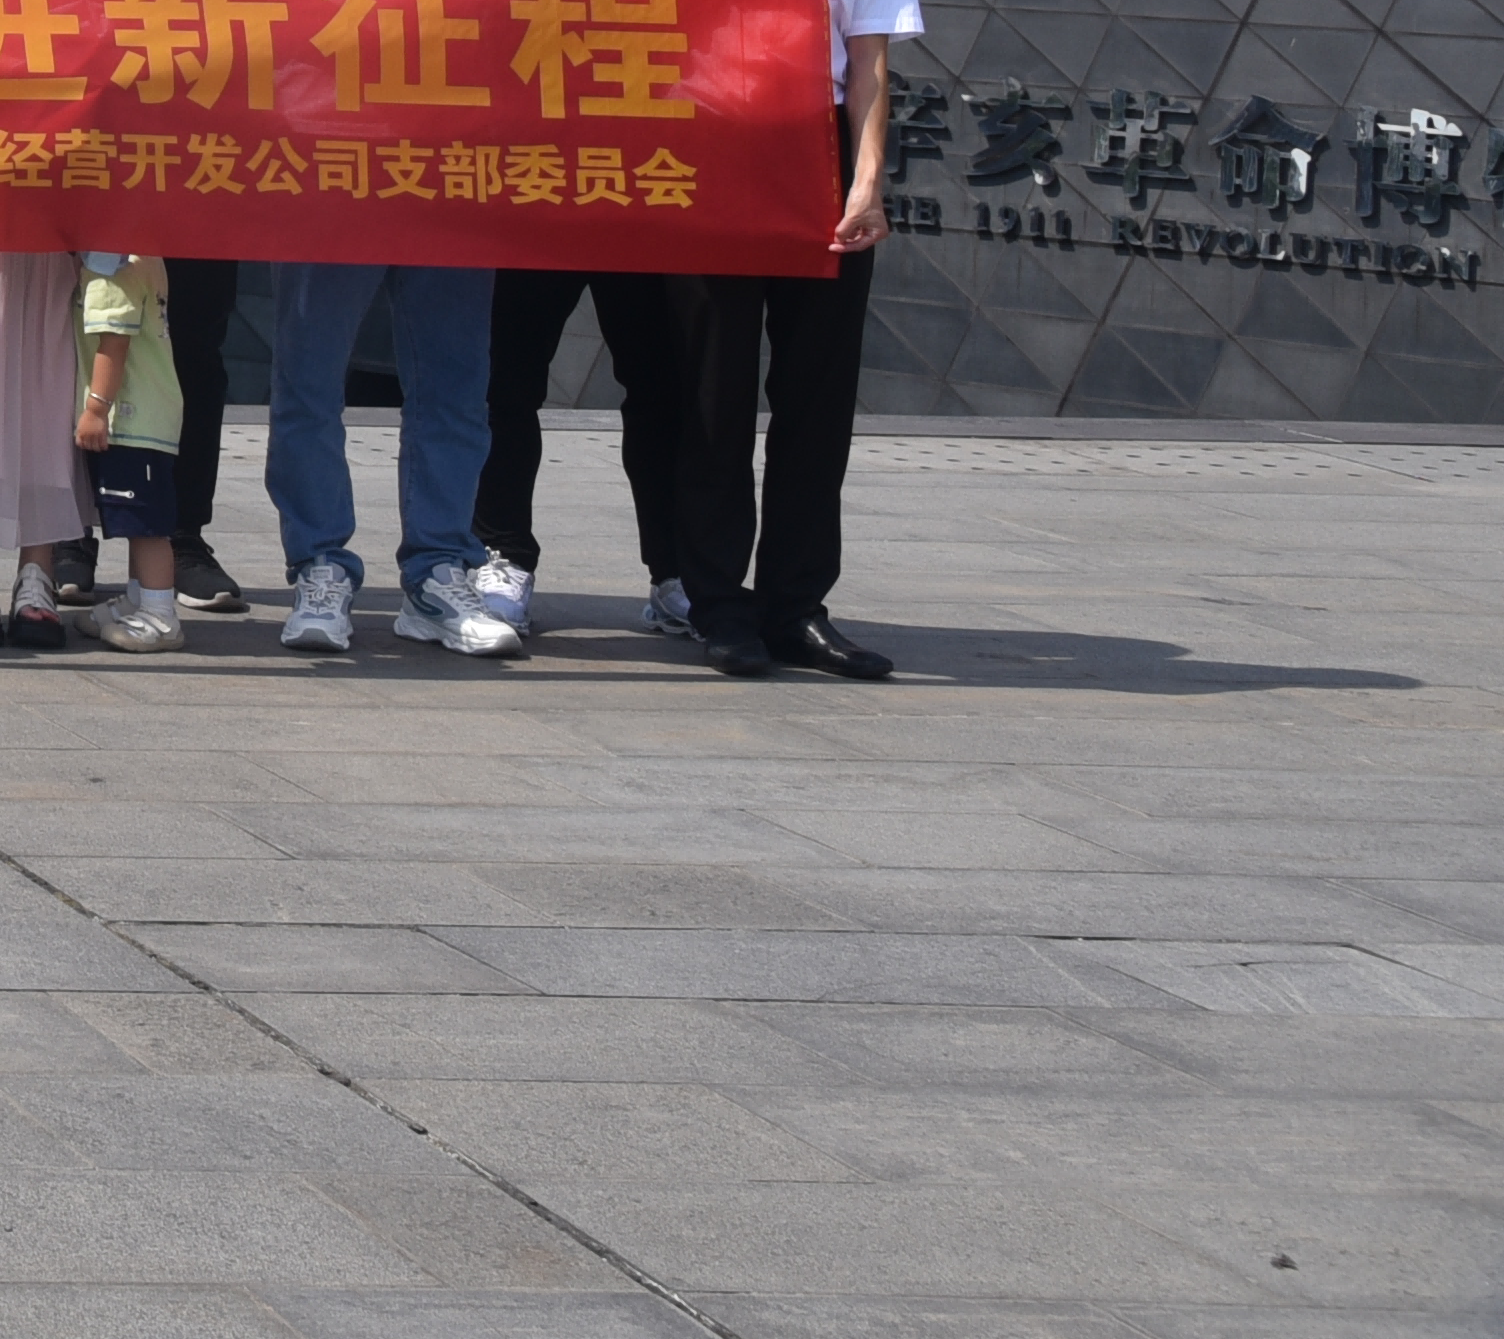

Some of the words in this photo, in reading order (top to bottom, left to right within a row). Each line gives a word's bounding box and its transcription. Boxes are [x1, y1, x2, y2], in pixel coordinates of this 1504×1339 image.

[886, 70, 1504, 224] 辛亥革命博
[976, 200, 1070, 237] 1911
[1110, 215, 1476, 281] REVOLUTION
